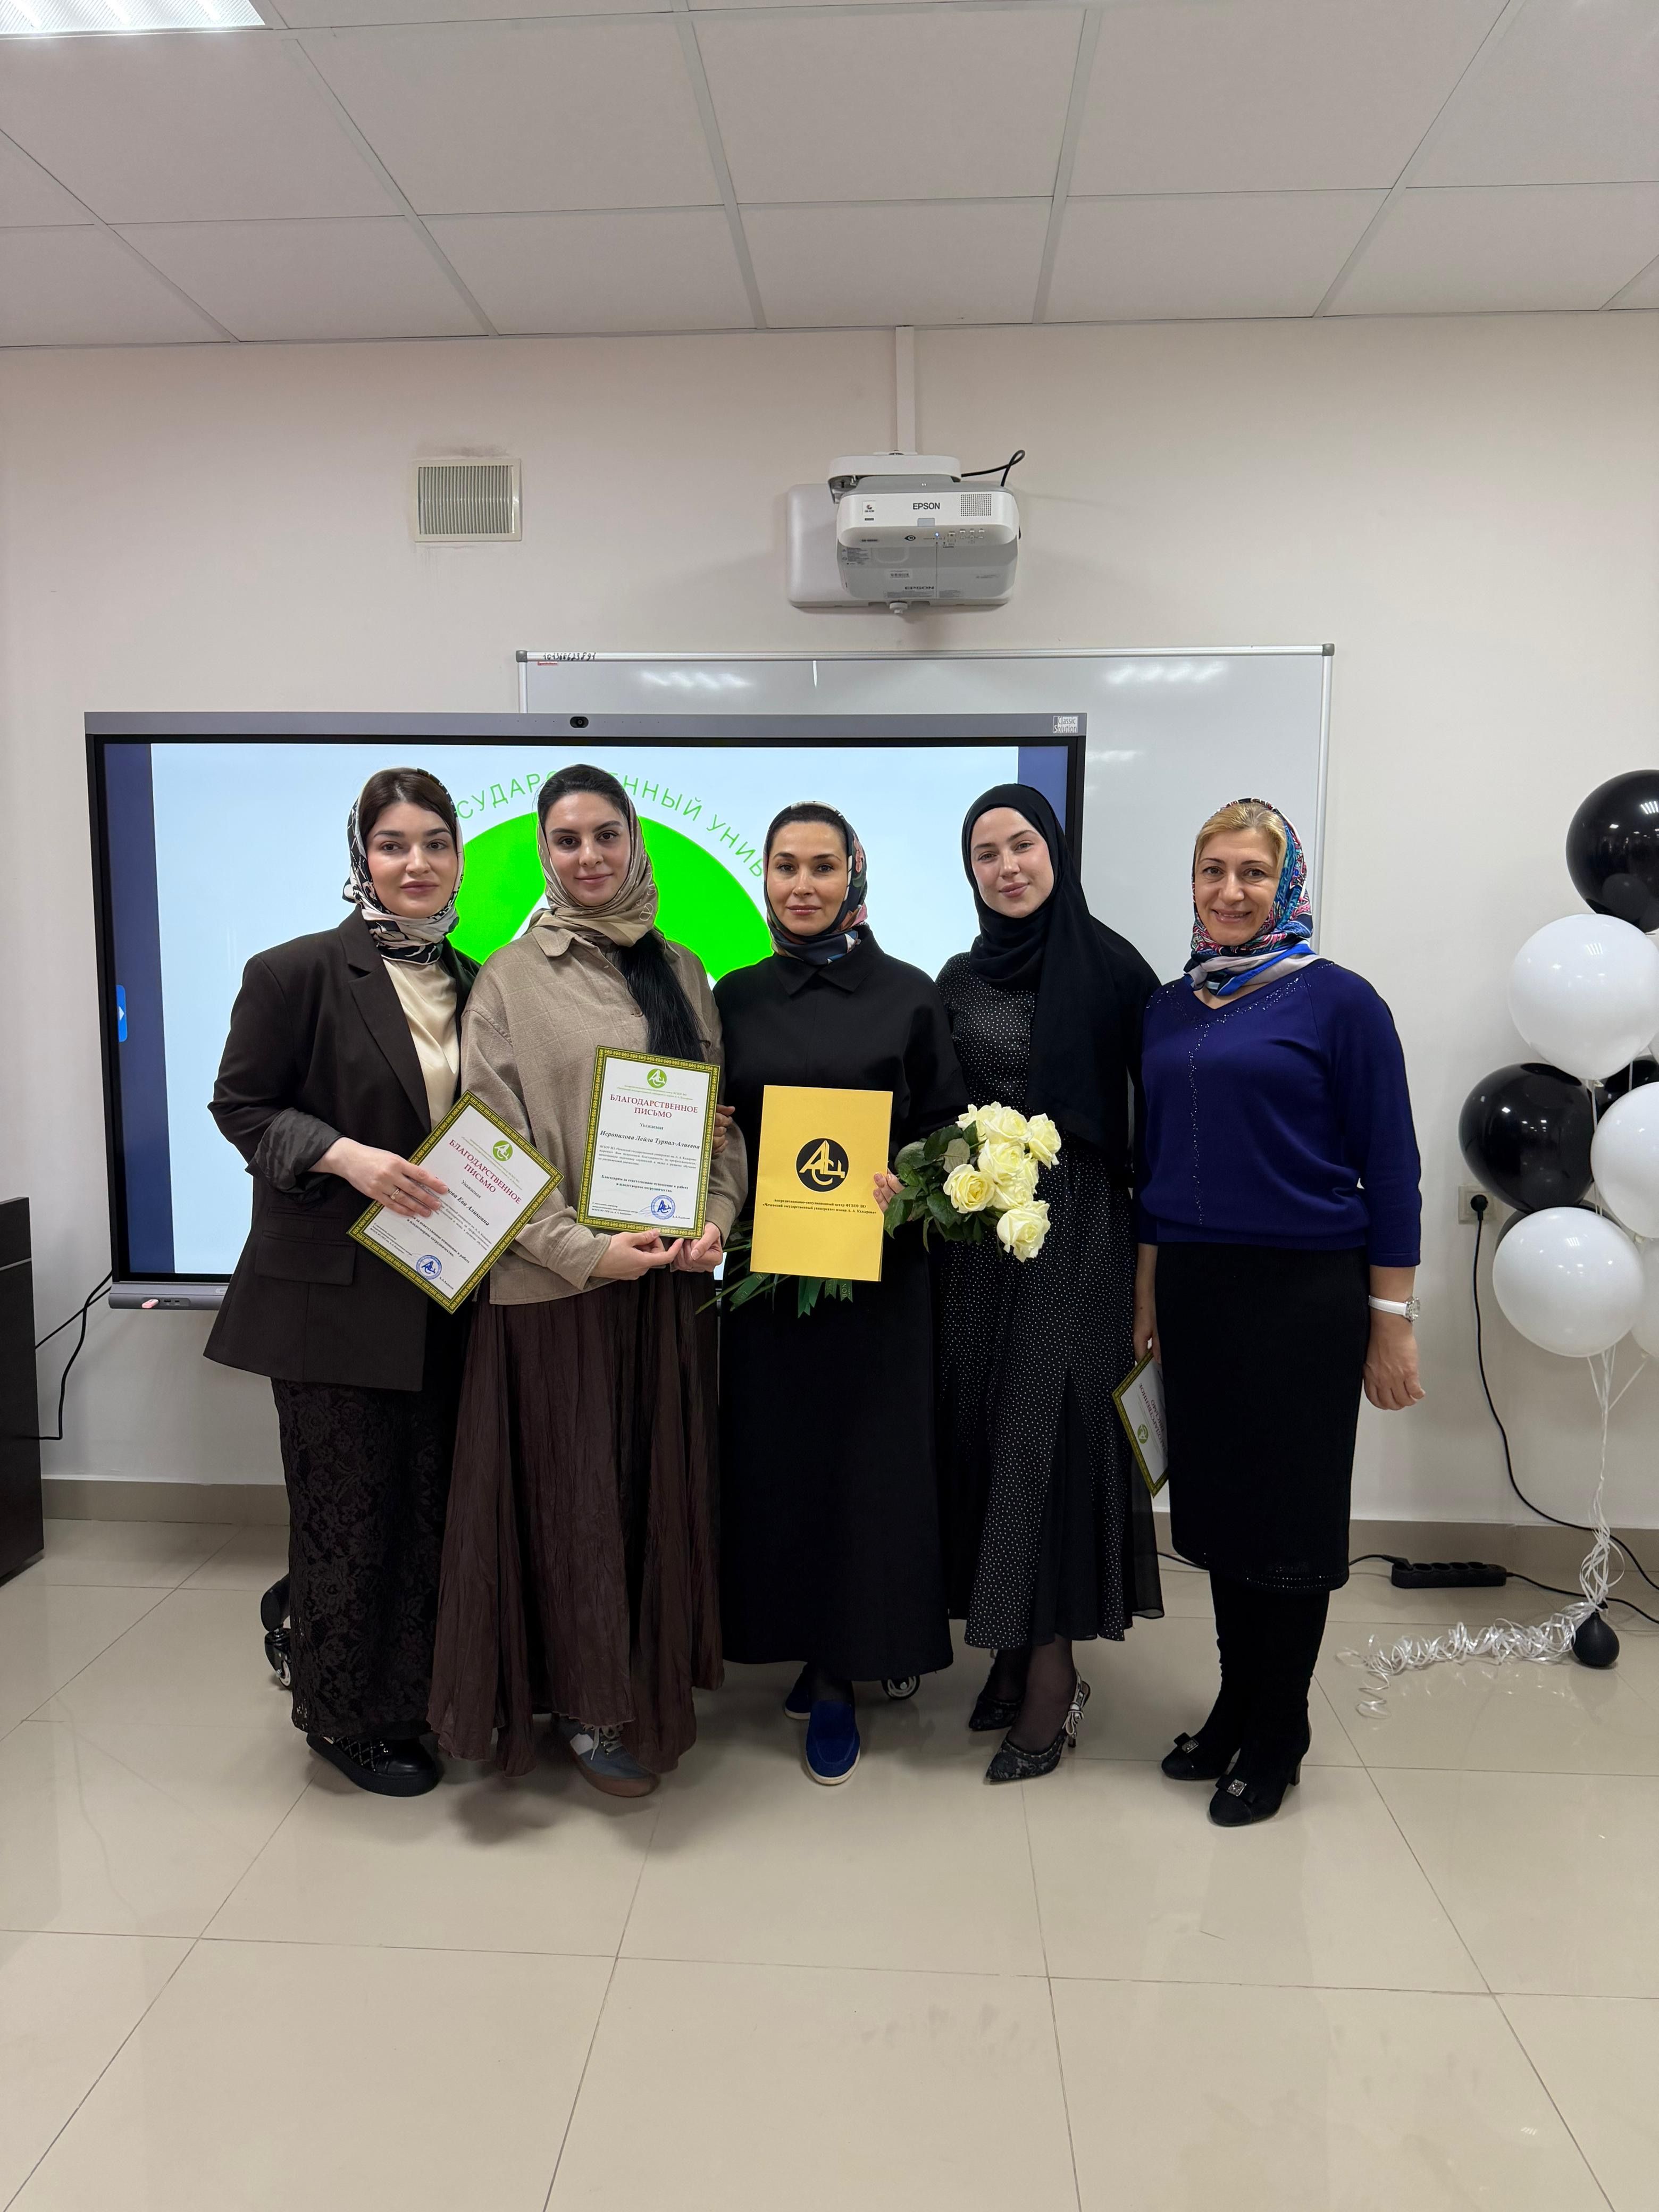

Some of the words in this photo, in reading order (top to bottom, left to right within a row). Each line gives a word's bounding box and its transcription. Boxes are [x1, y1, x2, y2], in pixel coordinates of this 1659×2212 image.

[610, 1094, 698, 1113] БЛАГОДАРСТВЕННОЕ
[634, 1107, 672, 1118] ПИСЬМО
[600, 1130, 634, 1141] Исропилова
[655, 1137, 700, 1149] Турпал-Алиевна
[449, 1139, 522, 1204] БЛАГОДАРСТВЕННОЕ
[464, 1163, 496, 1193] ПИСЬМО
